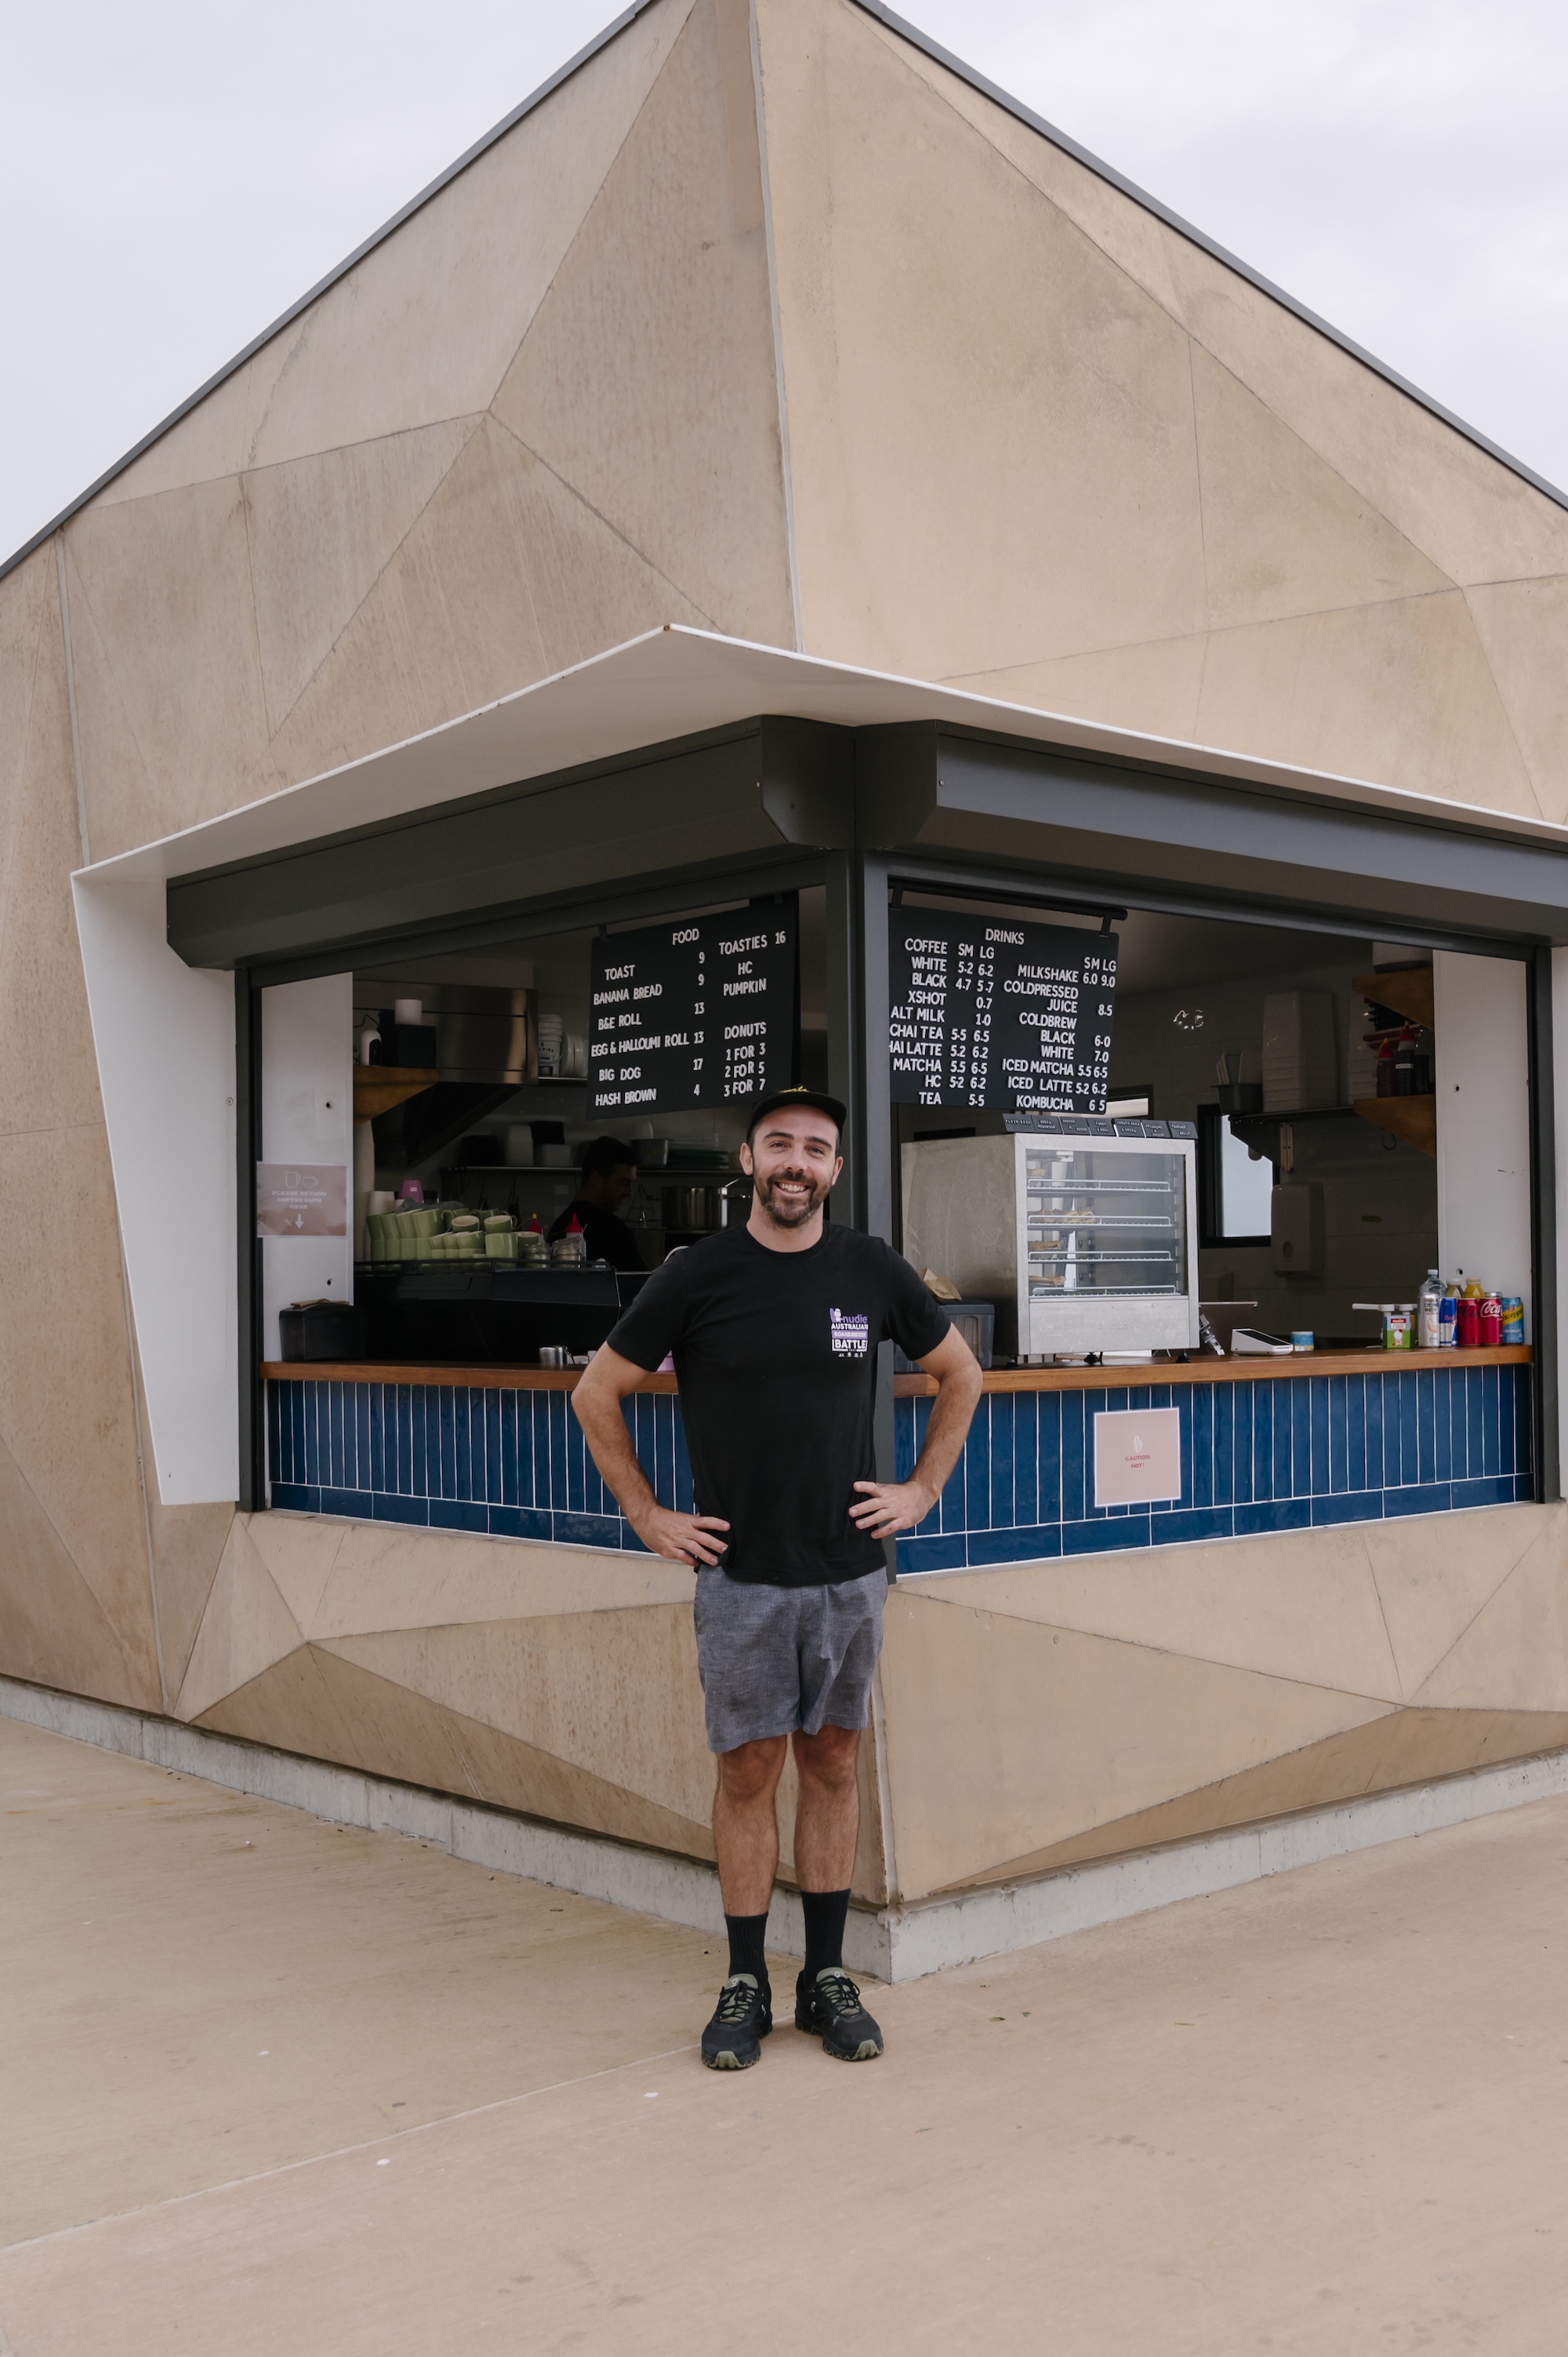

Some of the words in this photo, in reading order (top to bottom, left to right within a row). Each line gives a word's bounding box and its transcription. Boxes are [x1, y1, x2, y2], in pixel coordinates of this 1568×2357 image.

[673, 928, 699, 945] FOOD
[719, 935, 767, 954] TOASTIES
[775, 932, 786, 944] 16
[985, 928, 1024, 945] DRINKS
[905, 939, 948, 954] COFFEE
[958, 943, 973, 957] SM
[980, 946, 994, 959] LG
[604, 965, 635, 980] TOAST
[699, 952, 704, 963] 9
[739, 961, 752, 975] HC
[912, 957, 947, 971] WHITE
[958, 961, 973, 974] 5.2
[978, 964, 993, 977] 6.2
[1084, 957, 1099, 970] SM
[1103, 959, 1116, 971] LG
[913, 973, 947, 988] BLACK
[956, 978, 971, 990] 4.7
[977, 980, 993, 993] 5.7
[1018, 964, 1079, 982] MILKSHAKE
[1083, 972, 1098, 985] 6.0
[1102, 975, 1115, 987] 9.0
[593, 989, 629, 1005] BANANA
[633, 984, 662, 1000] BREAD
[699, 974, 704, 986] 9
[724, 979, 766, 996] PUMPKIN
[1004, 980, 1078, 999] COLDPRESSED
[908, 990, 946, 1005] XSHOT
[976, 997, 993, 1009] 0.7
[1047, 999, 1078, 1013] JUICE
[1098, 1004, 1112, 1016] 8.5
[598, 1017, 615, 1030] B&E
[619, 1013, 641, 1026] ROLL
[695, 1002, 704, 1014] 13
[891, 1006, 913, 1019] ALT
[916, 1008, 945, 1022] MILK
[976, 1014, 991, 1026] 1.0
[1019, 1012, 1076, 1030] COLDBREW
[724, 1022, 766, 1039] DONUTS
[889, 1024, 916, 1038] CHAI
[920, 1026, 943, 1040] TEA
[951, 1029, 967, 1040] 5.5
[974, 1030, 989, 1042] 6.5
[1040, 1030, 1075, 1044] BLACK
[1094, 1035, 1110, 1048] 6.0
[591, 1043, 608, 1057] EGG
[610, 1042, 616, 1054] &
[619, 1036, 660, 1052] HALLOUMI
[665, 1033, 689, 1047] ROLL
[694, 1031, 704, 1044] 13
[726, 1049, 731, 1060] 1
[735, 1045, 754, 1060] FOR
[760, 1043, 765, 1055] 3
[889, 1041, 904, 1054] HAI
[906, 1041, 942, 1056] LATTE
[950, 1045, 965, 1057] 5.2
[973, 1046, 988, 1059] 6.2
[1041, 1045, 1074, 1059] WHITE
[1094, 1051, 1109, 1062] 7.0
[599, 1069, 615, 1081] BIG
[620, 1067, 641, 1080] DOG
[694, 1059, 703, 1070] 17
[725, 1066, 731, 1077] 2
[734, 1061, 754, 1078] FOR
[758, 1062, 764, 1073] 5
[893, 1058, 942, 1072] MATCHA
[950, 1061, 966, 1073] 5.5
[971, 1062, 987, 1074] 6.5
[1003, 1059, 1029, 1072] ICED
[1030, 1061, 1074, 1076] MATCHA
[1078, 1065, 1091, 1077] 5.5
[1094, 1066, 1107, 1078] 6.5
[724, 1085, 730, 1097] 3
[733, 1079, 753, 1094] FOR
[760, 1079, 765, 1090] 7
[925, 1075, 942, 1088] HC
[949, 1076, 964, 1088] 5.2
[971, 1077, 986, 1089] 6.2
[1008, 1077, 1033, 1089] ICED
[1040, 1079, 1073, 1093] LATTE
[1076, 1083, 1089, 1095] 5.2
[1092, 1083, 1107, 1095] 6.2
[596, 1092, 620, 1106] HASH
[625, 1088, 656, 1104] BROWN
[694, 1084, 699, 1095] 4
[919, 1092, 942, 1104] TEA
[969, 1094, 984, 1106] 5.5
[1017, 1095, 1073, 1110] KOMBUCHA
[843, 1314, 867, 1323] nudie
[835, 1339, 866, 1349] BATTLE
